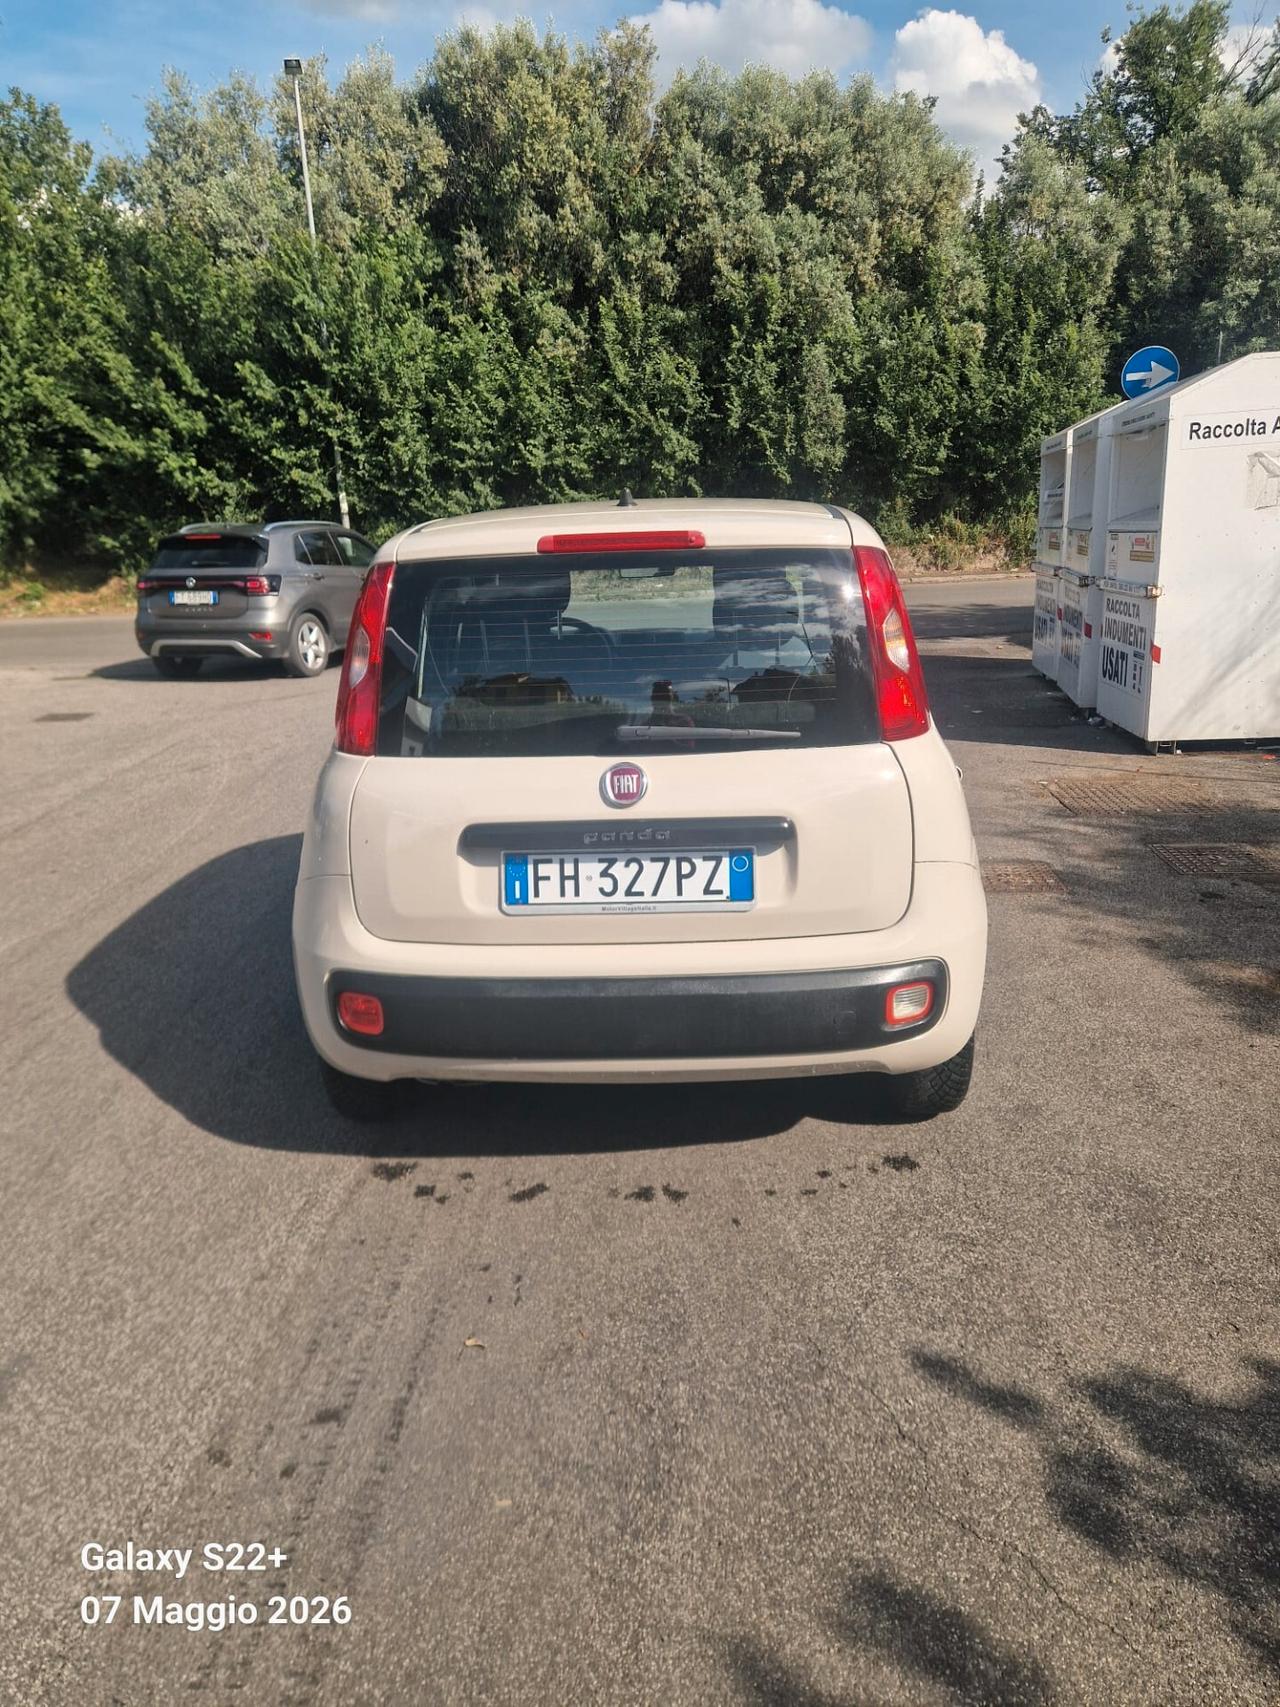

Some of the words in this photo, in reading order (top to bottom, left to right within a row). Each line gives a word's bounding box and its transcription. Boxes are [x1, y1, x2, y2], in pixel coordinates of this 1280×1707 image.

[1189, 417, 1266, 440] Raccolta
[1106, 597, 1140, 620] RACCOLTA
[1104, 617, 1147, 651] INDUMENTI
[1102, 645, 1129, 687] USATI
[613, 773, 639, 795] FIAT
[532, 857, 580, 899] FH
[597, 855, 724, 898] 327PZ
